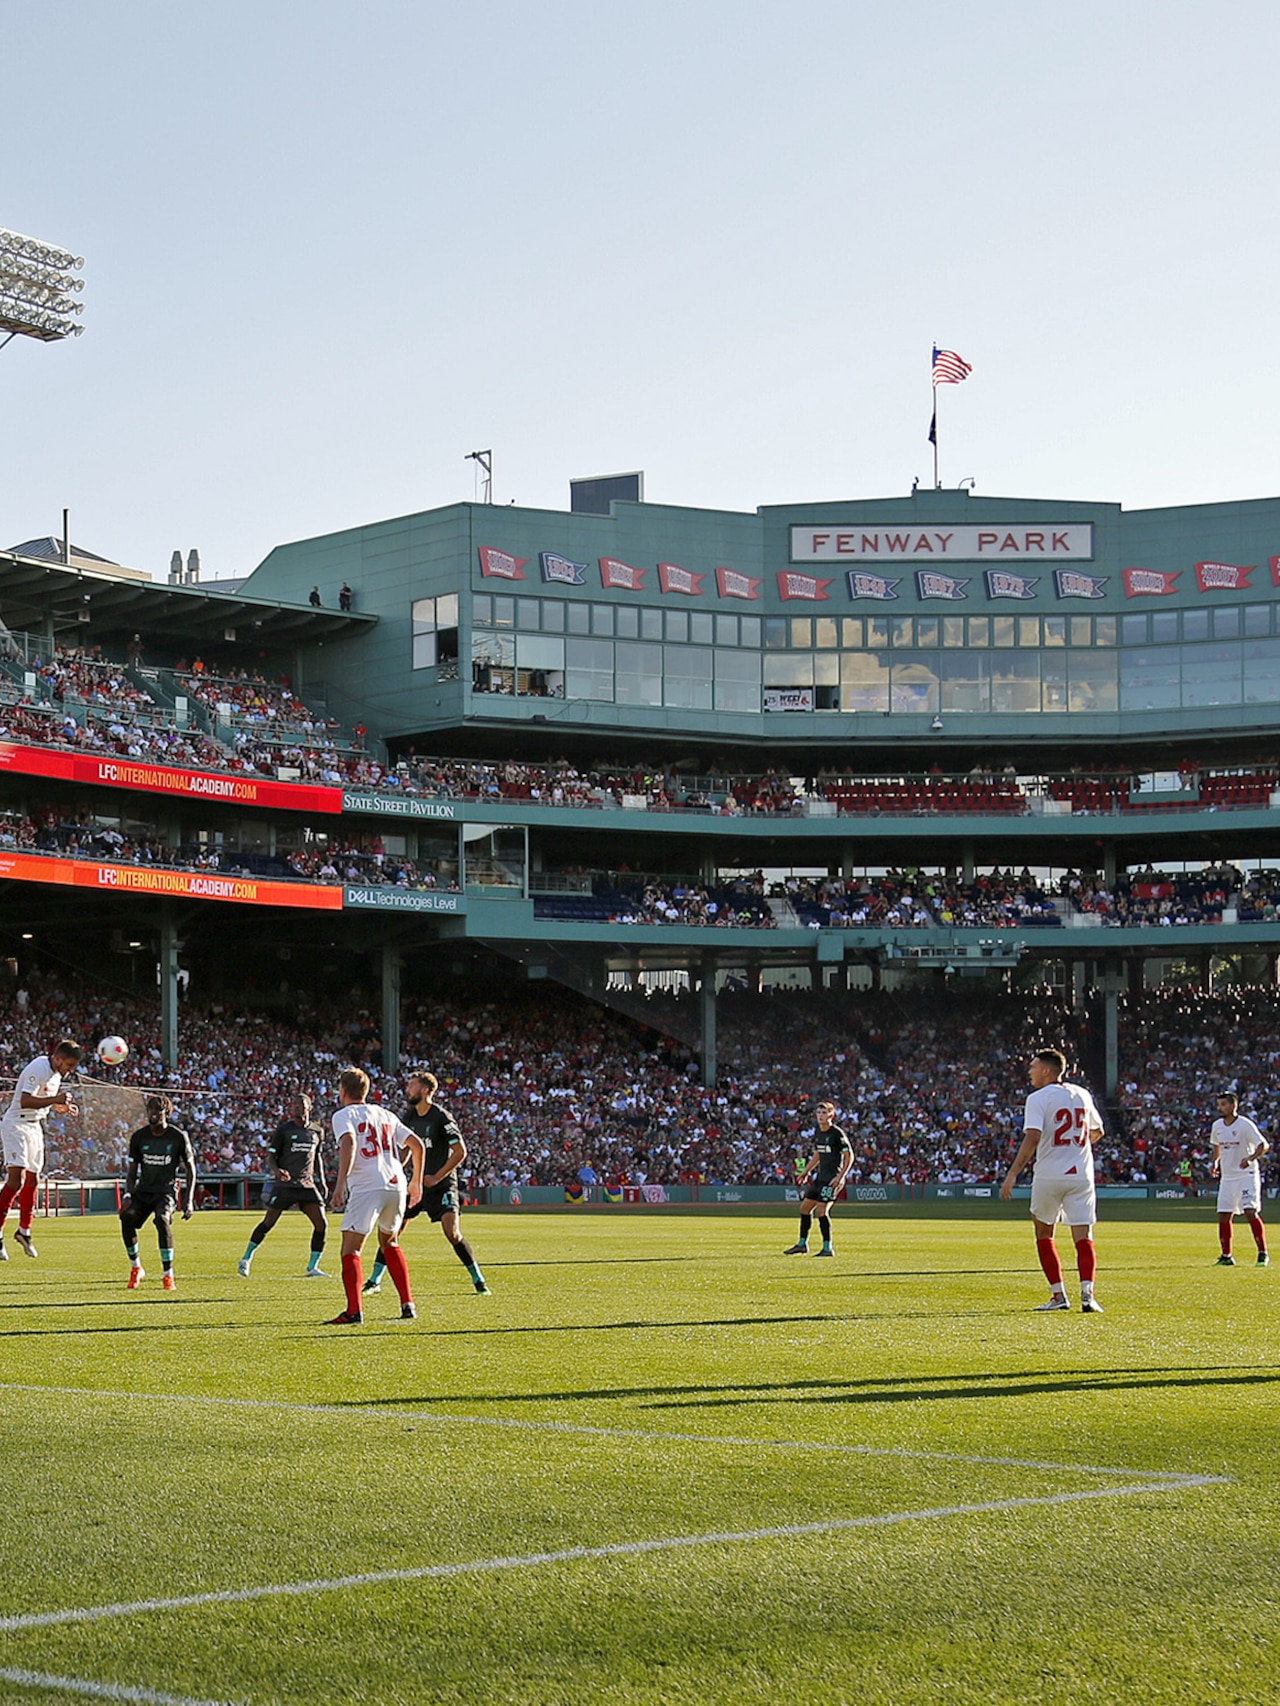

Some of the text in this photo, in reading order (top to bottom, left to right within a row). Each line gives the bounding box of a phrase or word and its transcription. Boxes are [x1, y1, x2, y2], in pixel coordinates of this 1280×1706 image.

[812, 532, 1070, 553] FENWAY PARK
[1130, 574, 1164, 589] 2004
[1202, 568, 1239, 583] 2007
[98, 763, 257, 800] LFCINTERNATIONALACADEMY.COM
[344, 794, 372, 810] STATE
[410, 800, 454, 817] PAVILION
[98, 868, 257, 899] LFCINTERNATIONALACADEMY.COM
[348, 890, 457, 910] DELL Technologies Level
[1052, 1107, 1088, 1147] 25
[357, 1121, 399, 1159] 34
[821, 1186, 833, 1197] 58
